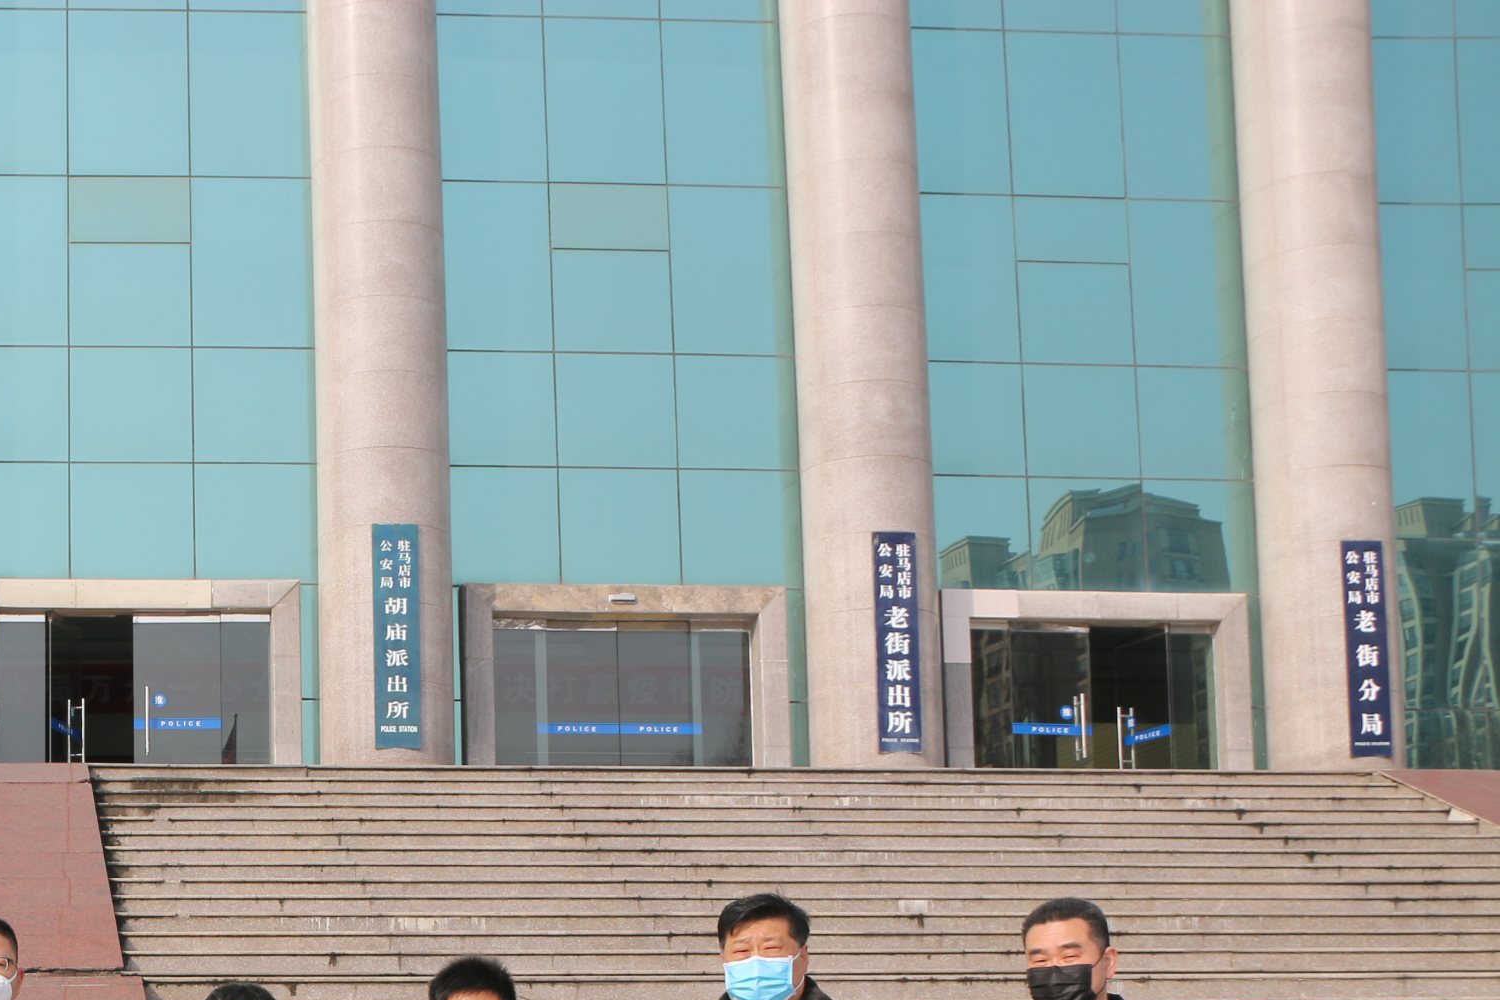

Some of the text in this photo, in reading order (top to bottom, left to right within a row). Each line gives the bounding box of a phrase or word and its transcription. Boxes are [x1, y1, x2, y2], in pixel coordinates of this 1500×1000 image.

[380, 540, 393, 589] 公安局
[398, 540, 412, 589] 驻马店市
[877, 543, 894, 599] 公安局
[895, 543, 912, 599] 驻马店市
[1345, 551, 1362, 605] 公安局
[1363, 551, 1381, 605] 驻马店市
[385, 598, 409, 719] 胡庙派出所
[884, 606, 913, 734] 老街派出所
[1354, 610, 1383, 736] 老街分局
[380, 725, 418, 733] POLICE STATION
[557, 725, 597, 733] POLICE
[1031, 726, 1070, 734] POLICE
[1134, 730, 1161, 741] POLICE
